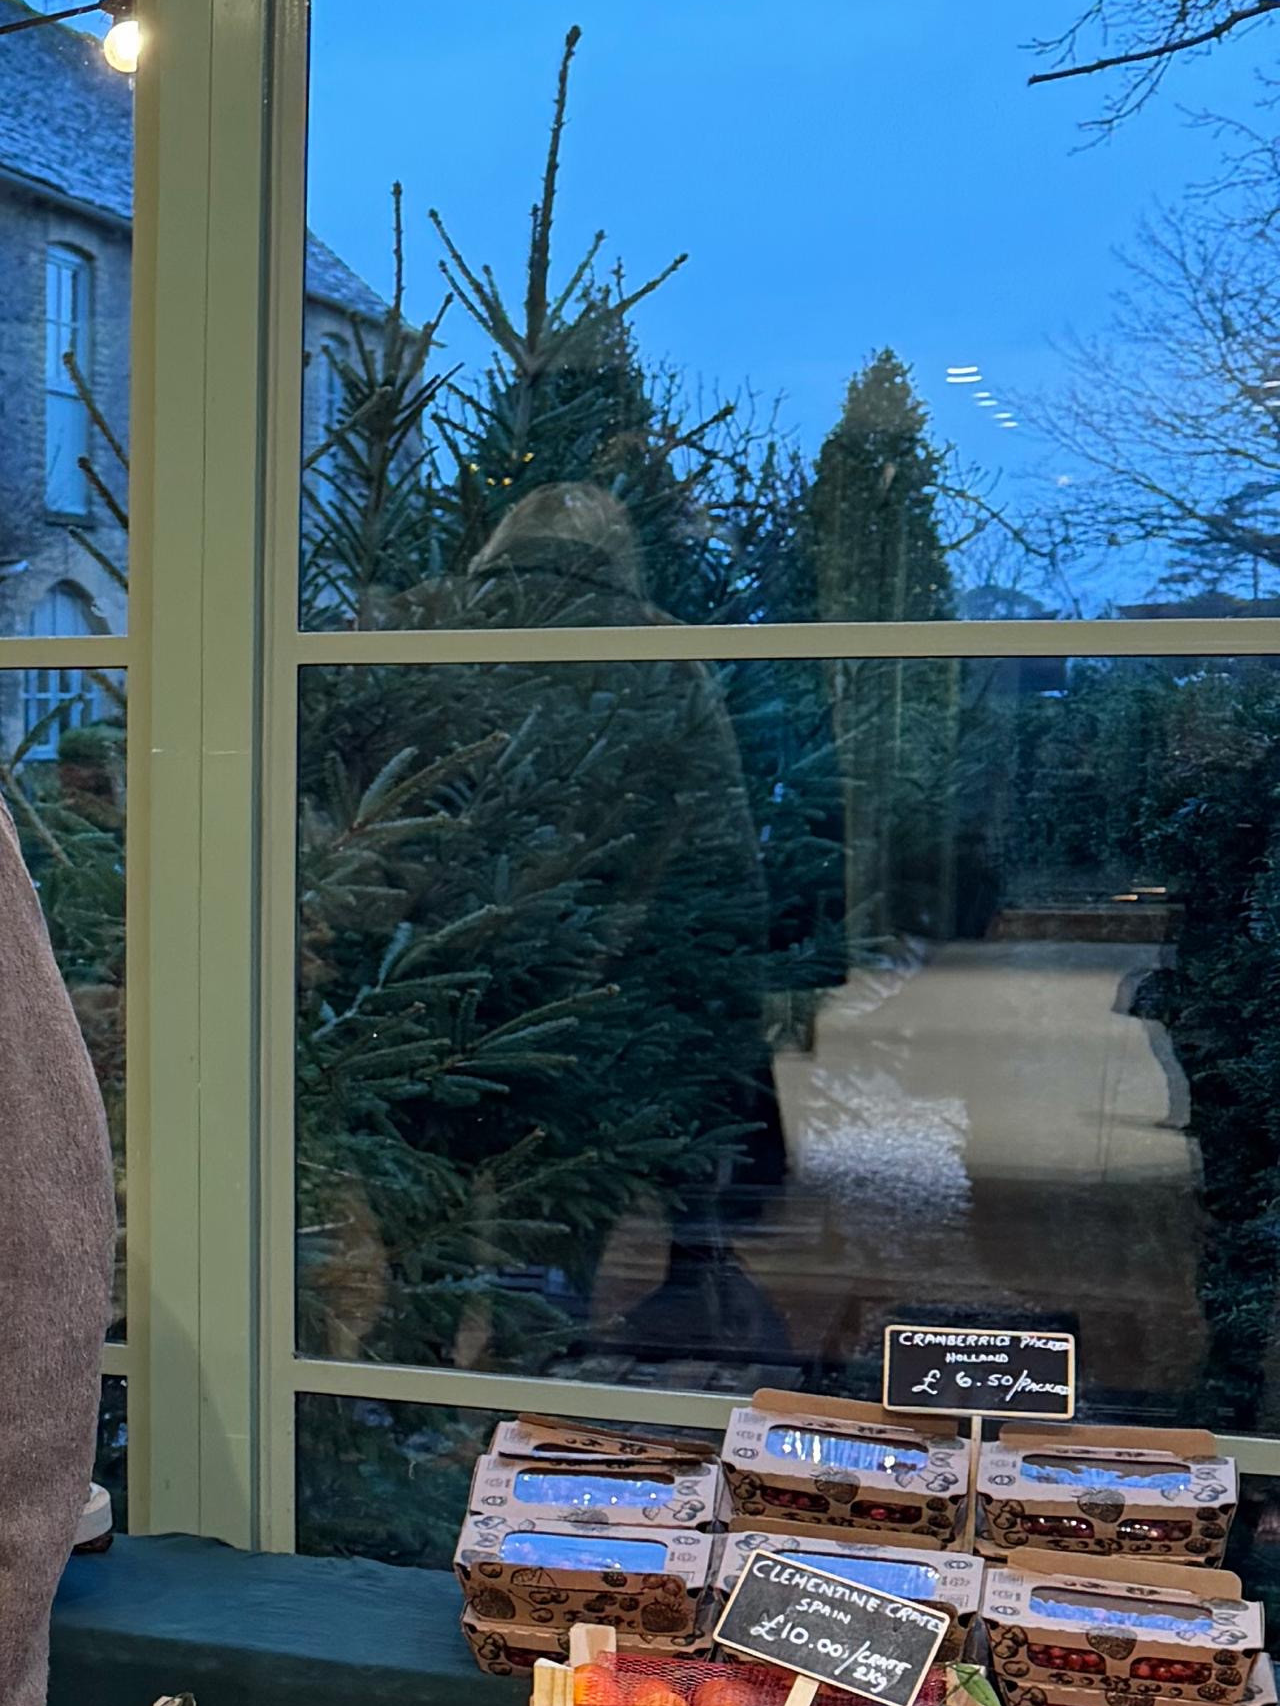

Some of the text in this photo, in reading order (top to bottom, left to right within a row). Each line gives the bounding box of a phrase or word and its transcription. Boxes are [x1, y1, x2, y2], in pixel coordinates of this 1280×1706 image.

[945, 1352, 1009, 1363] HOLLAND
[753, 1560, 882, 1612] CLEMENTINE
[795, 1598, 852, 1625] SPAIN
